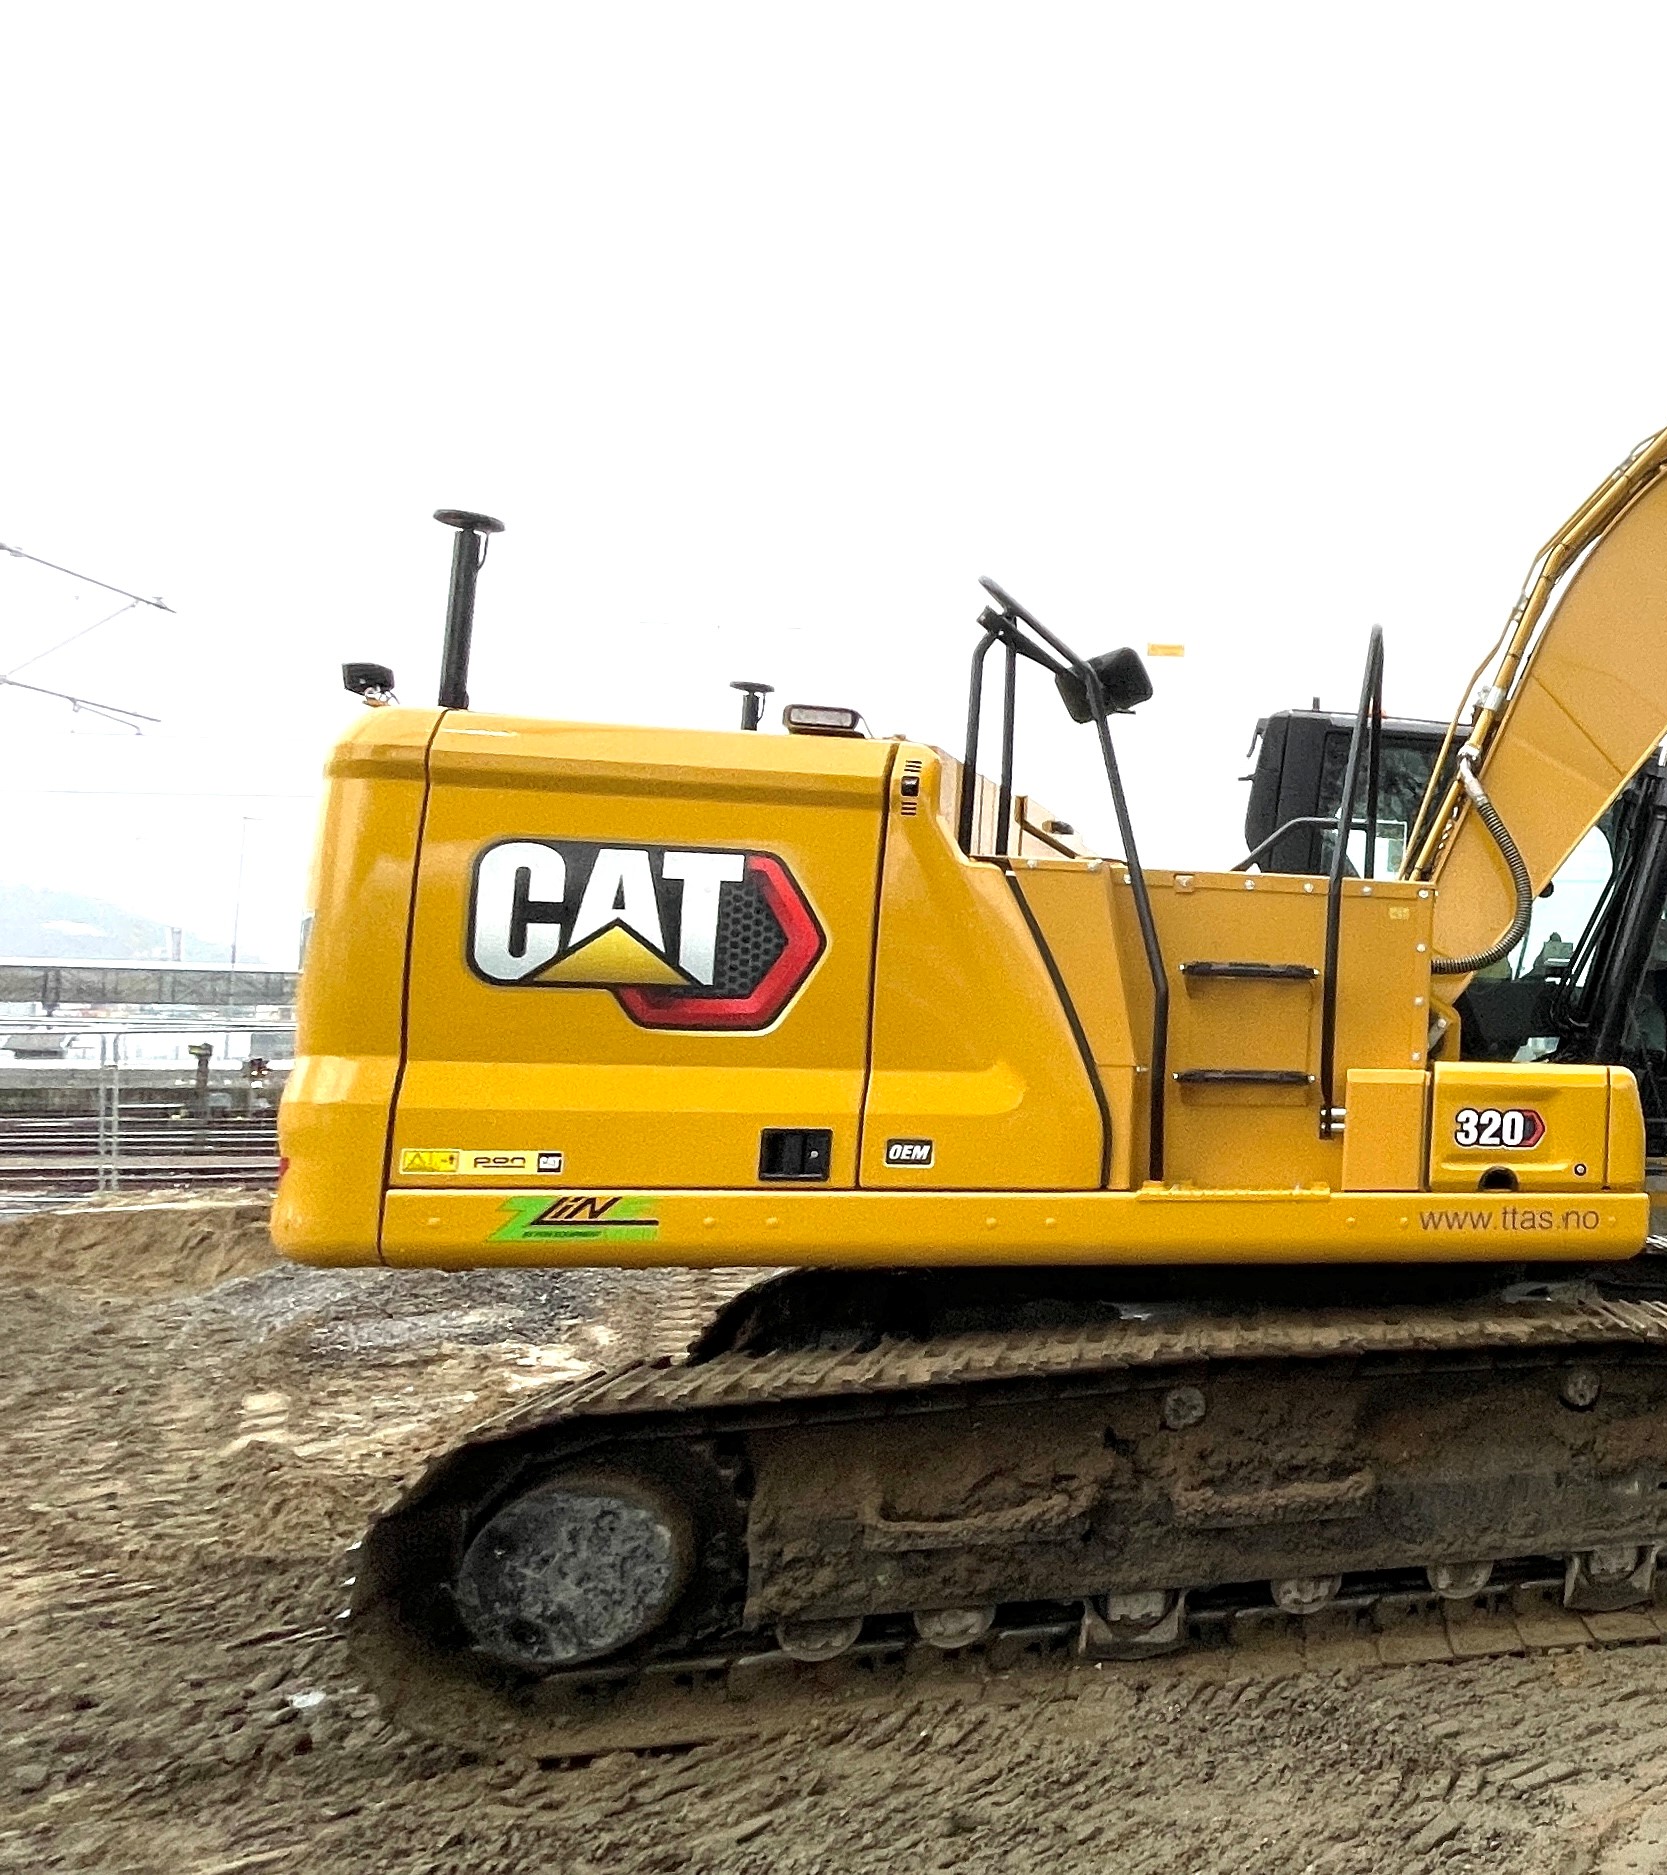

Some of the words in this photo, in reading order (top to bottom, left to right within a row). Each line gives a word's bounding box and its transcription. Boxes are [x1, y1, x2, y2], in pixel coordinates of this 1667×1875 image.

[473, 842, 746, 986] CAT
[1455, 1109, 1525, 1146] 320
[473, 1156, 526, 1169] pon
[888, 1144, 931, 1160] OEM
[1419, 1206, 1600, 1231] www.ttas.no
